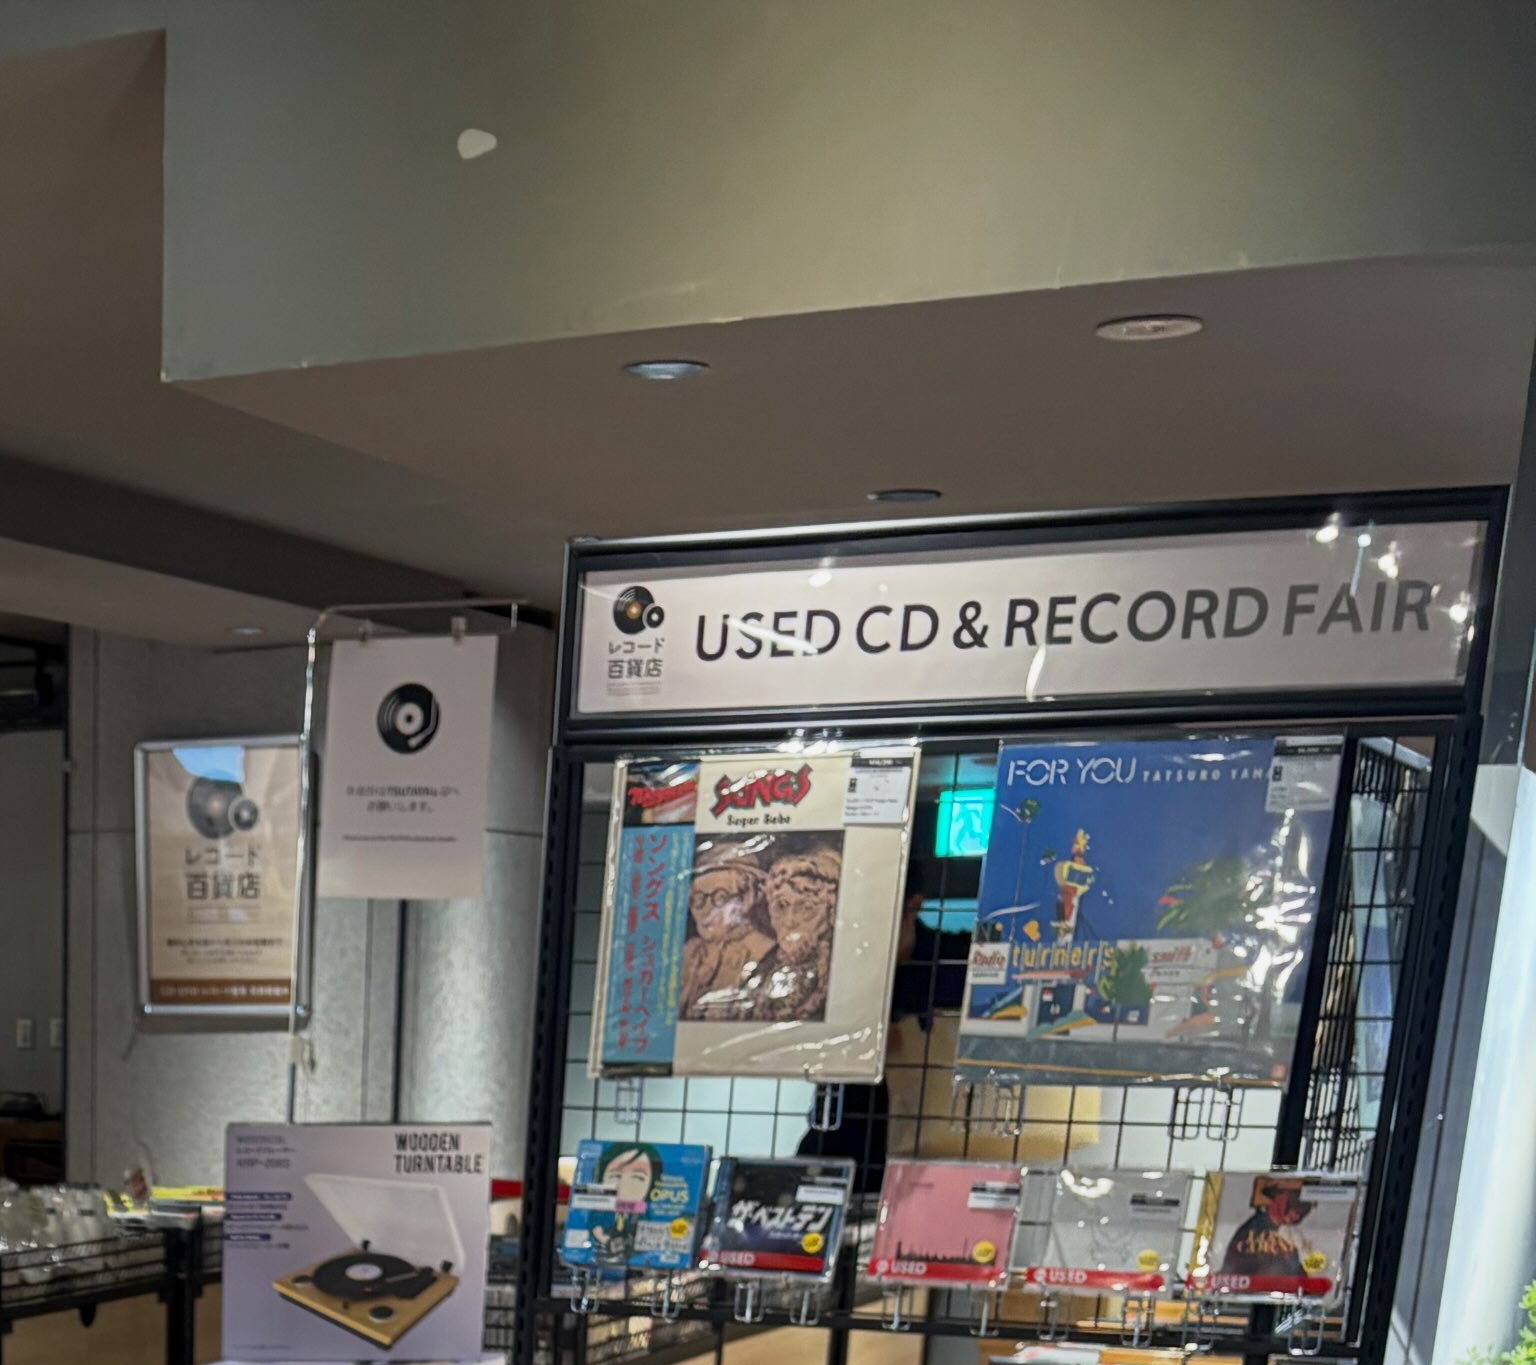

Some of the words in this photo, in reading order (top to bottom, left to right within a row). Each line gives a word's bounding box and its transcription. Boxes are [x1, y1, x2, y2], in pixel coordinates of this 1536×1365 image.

[697, 608, 841, 661] USED
[856, 604, 939, 655] CD
[952, 600, 989, 649] &
[1004, 587, 1269, 648] RECORD
[1282, 579, 1435, 637] FAIR
[608, 637, 665, 655] レコード
[608, 658, 663, 679] 百貨店
[1007, 758, 1069, 787] FOR
[1074, 756, 1137, 785] YOU
[1141, 768, 1222, 783] TATSURO
[1230, 766, 1270, 782] YAM
[394, 1133, 462, 1153] WOODEN
[394, 1155, 484, 1175] TURNTABLE
[720, 1250, 756, 1266] USED
[890, 1260, 928, 1276] USED
[1049, 1268, 1088, 1285] USED
[1211, 1274, 1252, 1291] USED
